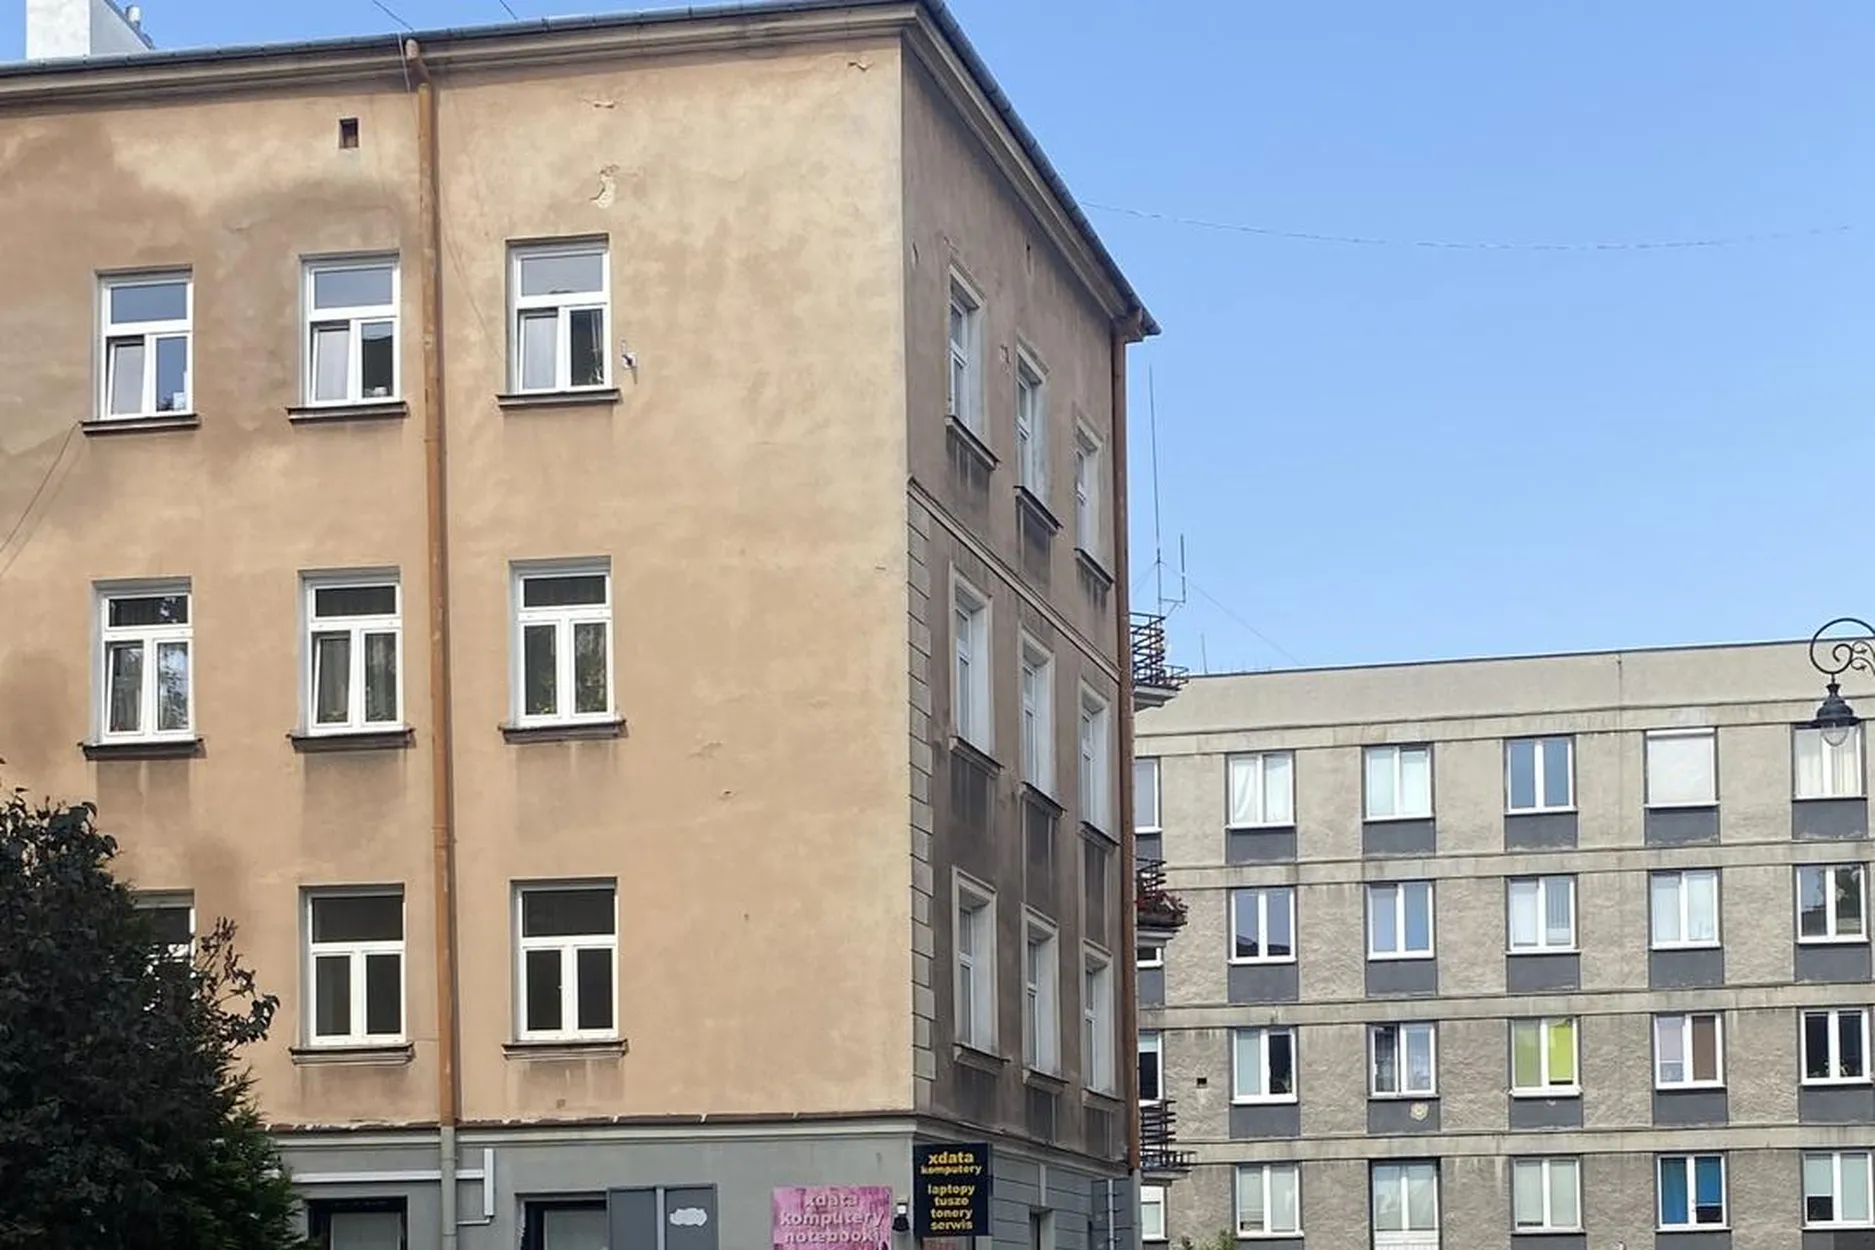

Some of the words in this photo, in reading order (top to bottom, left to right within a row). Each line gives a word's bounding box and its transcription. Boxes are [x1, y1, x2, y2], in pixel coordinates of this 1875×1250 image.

[928, 1151, 975, 1165] xdata
[920, 1165, 982, 1176] komputery
[927, 1184, 976, 1196] laptopy
[806, 1194, 859, 1209] xdata
[781, 1211, 884, 1228] komputery
[930, 1208, 973, 1219] tonery
[930, 1219, 973, 1230] serwis
